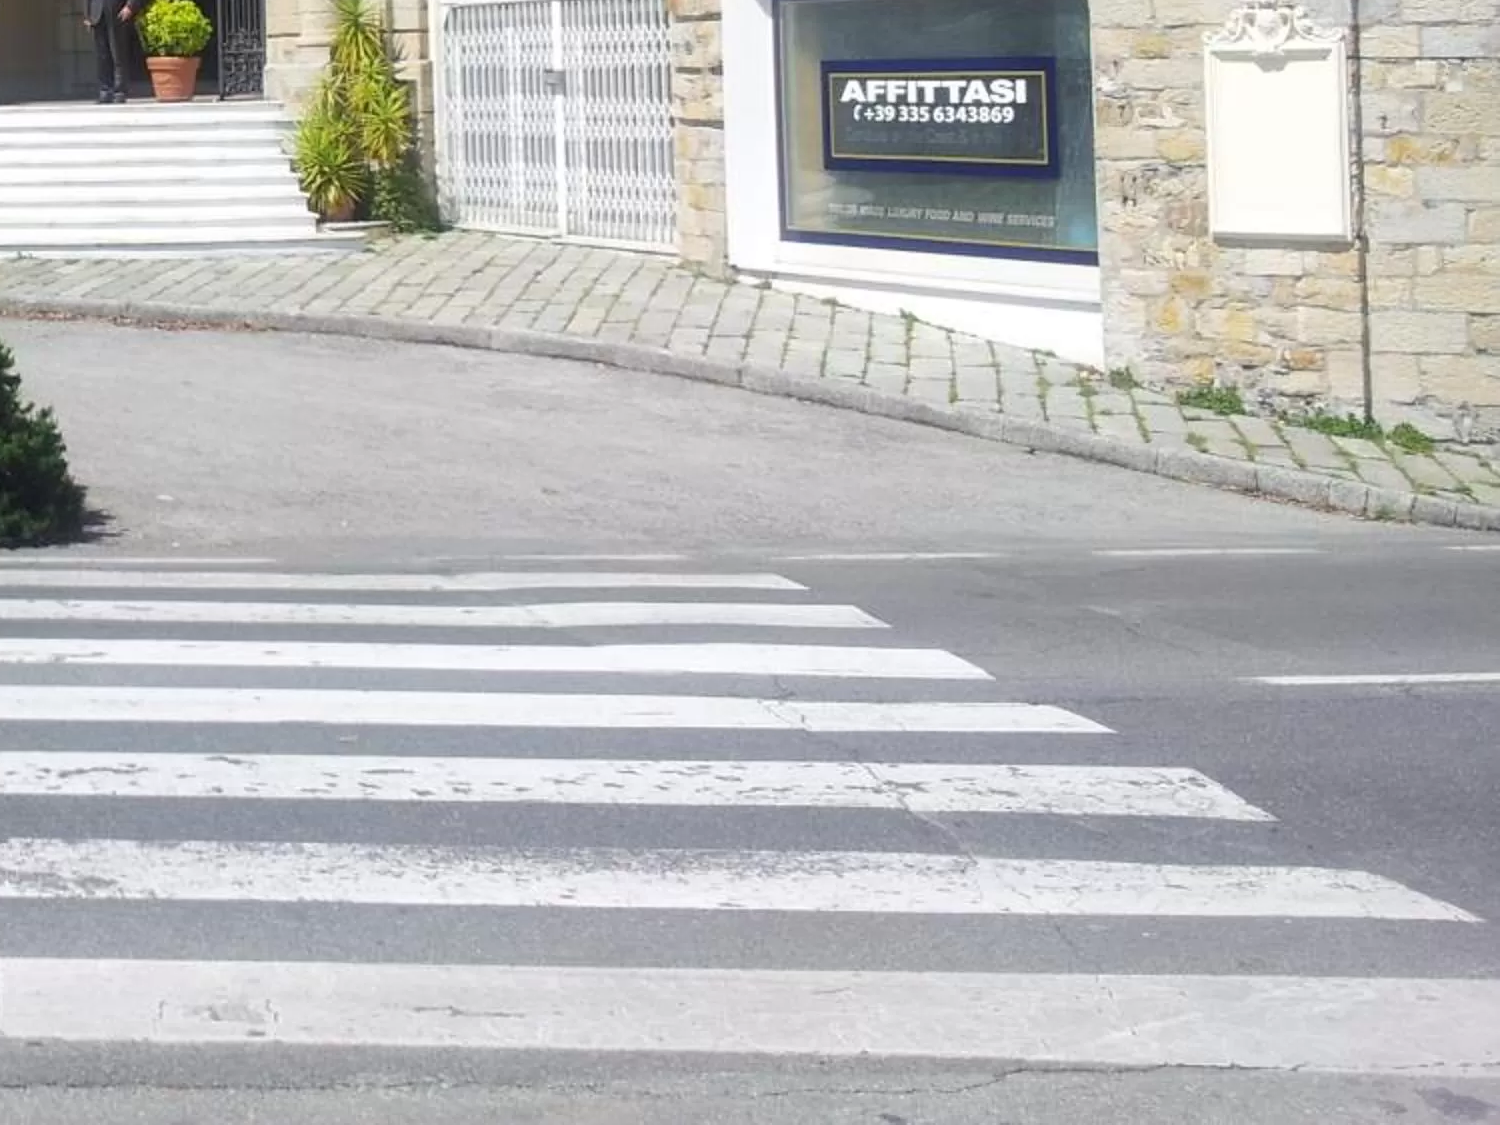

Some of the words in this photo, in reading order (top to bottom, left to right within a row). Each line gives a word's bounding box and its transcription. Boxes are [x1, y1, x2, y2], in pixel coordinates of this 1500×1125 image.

[841, 79, 1027, 104] AFFITTASI
[898, 106, 929, 123] 335
[933, 106, 1014, 123] 6343869
[925, 208, 950, 221] FOOD
[952, 210, 975, 223] AND
